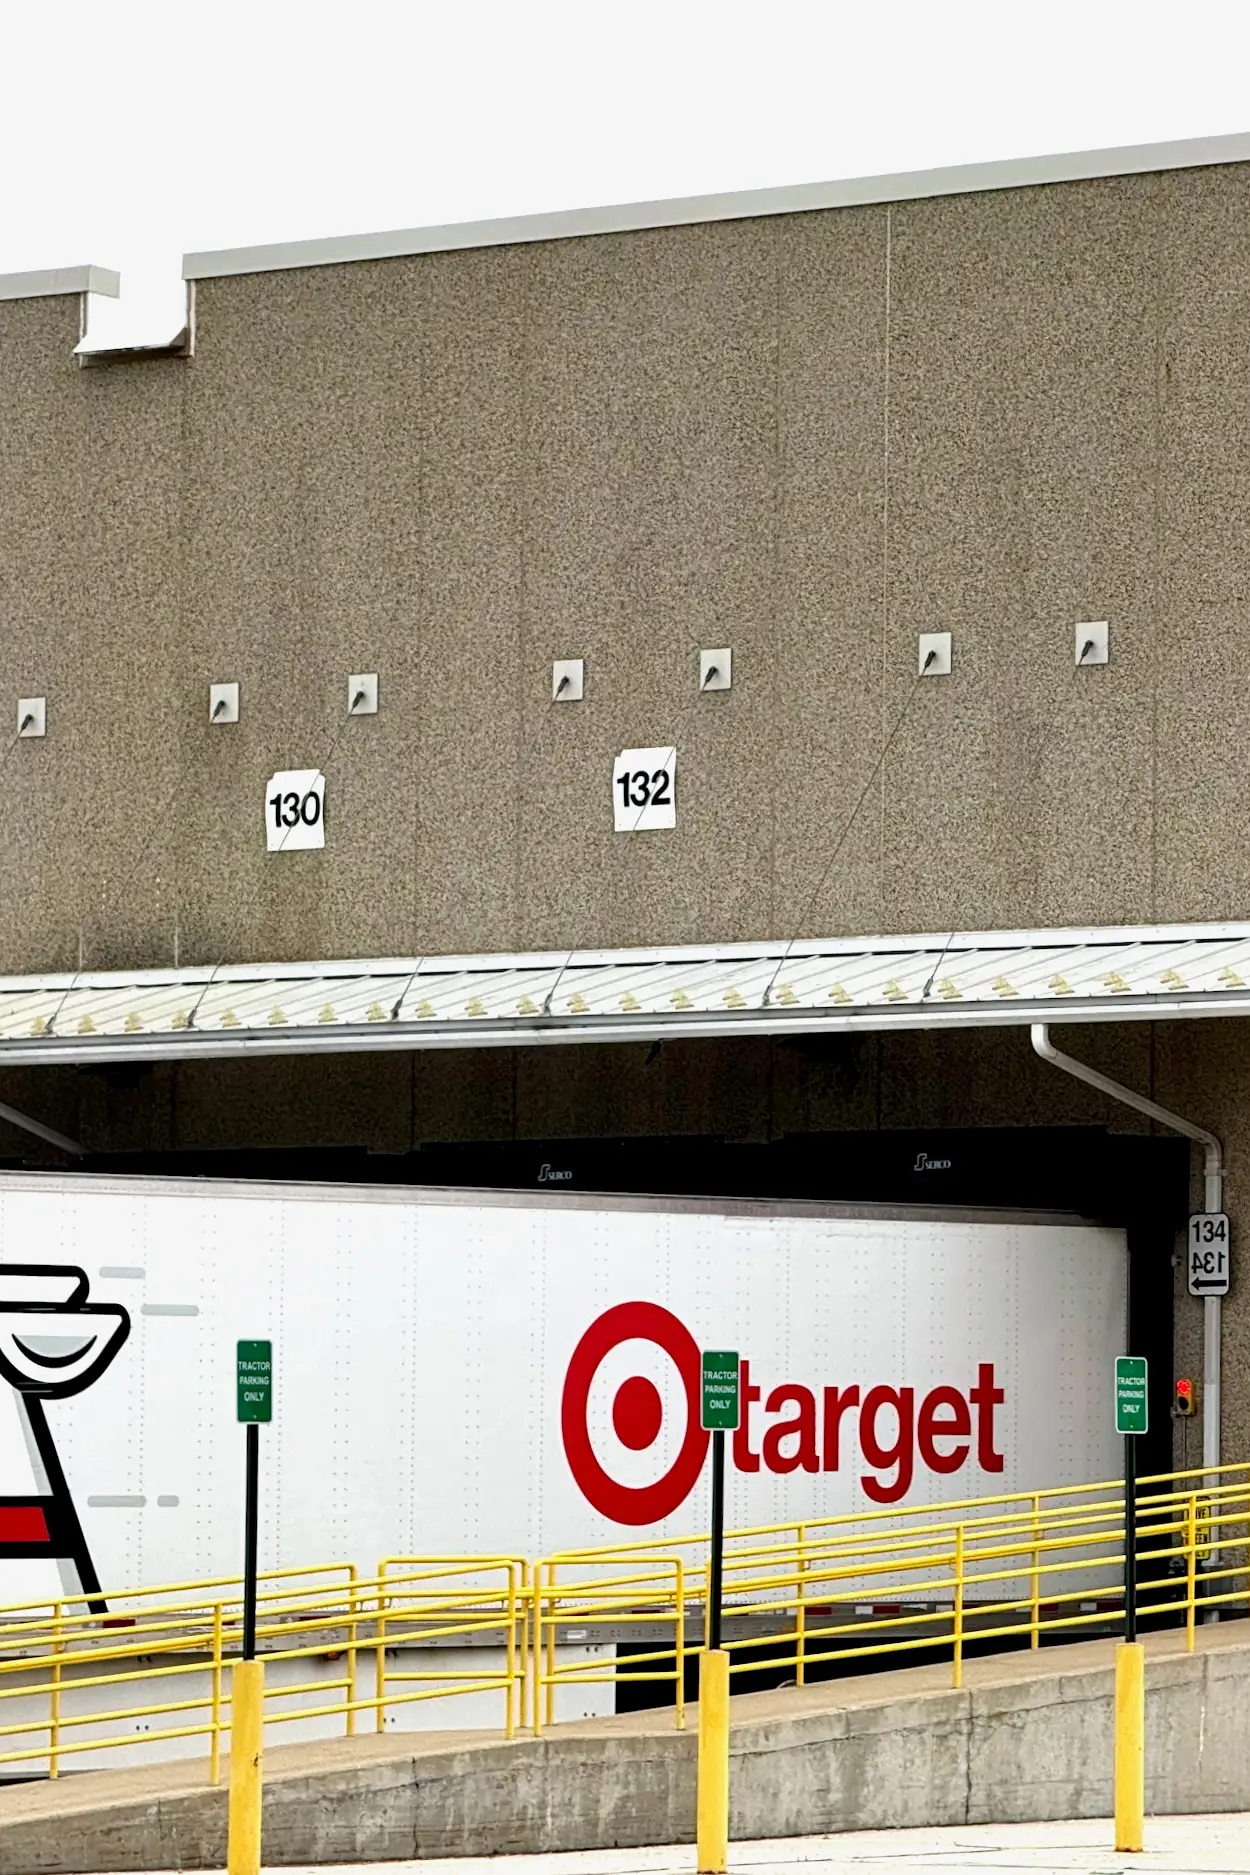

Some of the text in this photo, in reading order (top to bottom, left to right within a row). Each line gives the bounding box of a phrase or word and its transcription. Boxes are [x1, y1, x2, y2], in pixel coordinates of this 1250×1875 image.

[617, 770, 670, 807] 132
[270, 791, 320, 827] 130
[1192, 1220, 1226, 1242] 134
[238, 1361, 270, 1370] TRACTOR
[704, 1371, 738, 1380] TRACTOR
[239, 1376, 269, 1385] PARKING
[1118, 1376, 1145, 1385] TRACTOR
[704, 1385, 736, 1394] PARKING
[1118, 1390, 1144, 1398] PARKING
[244, 1392, 264, 1402] ONLY
[709, 1400, 731, 1409] ONLY
[1122, 1404, 1140, 1413] ONLY
[732, 1360, 1004, 1504] target
